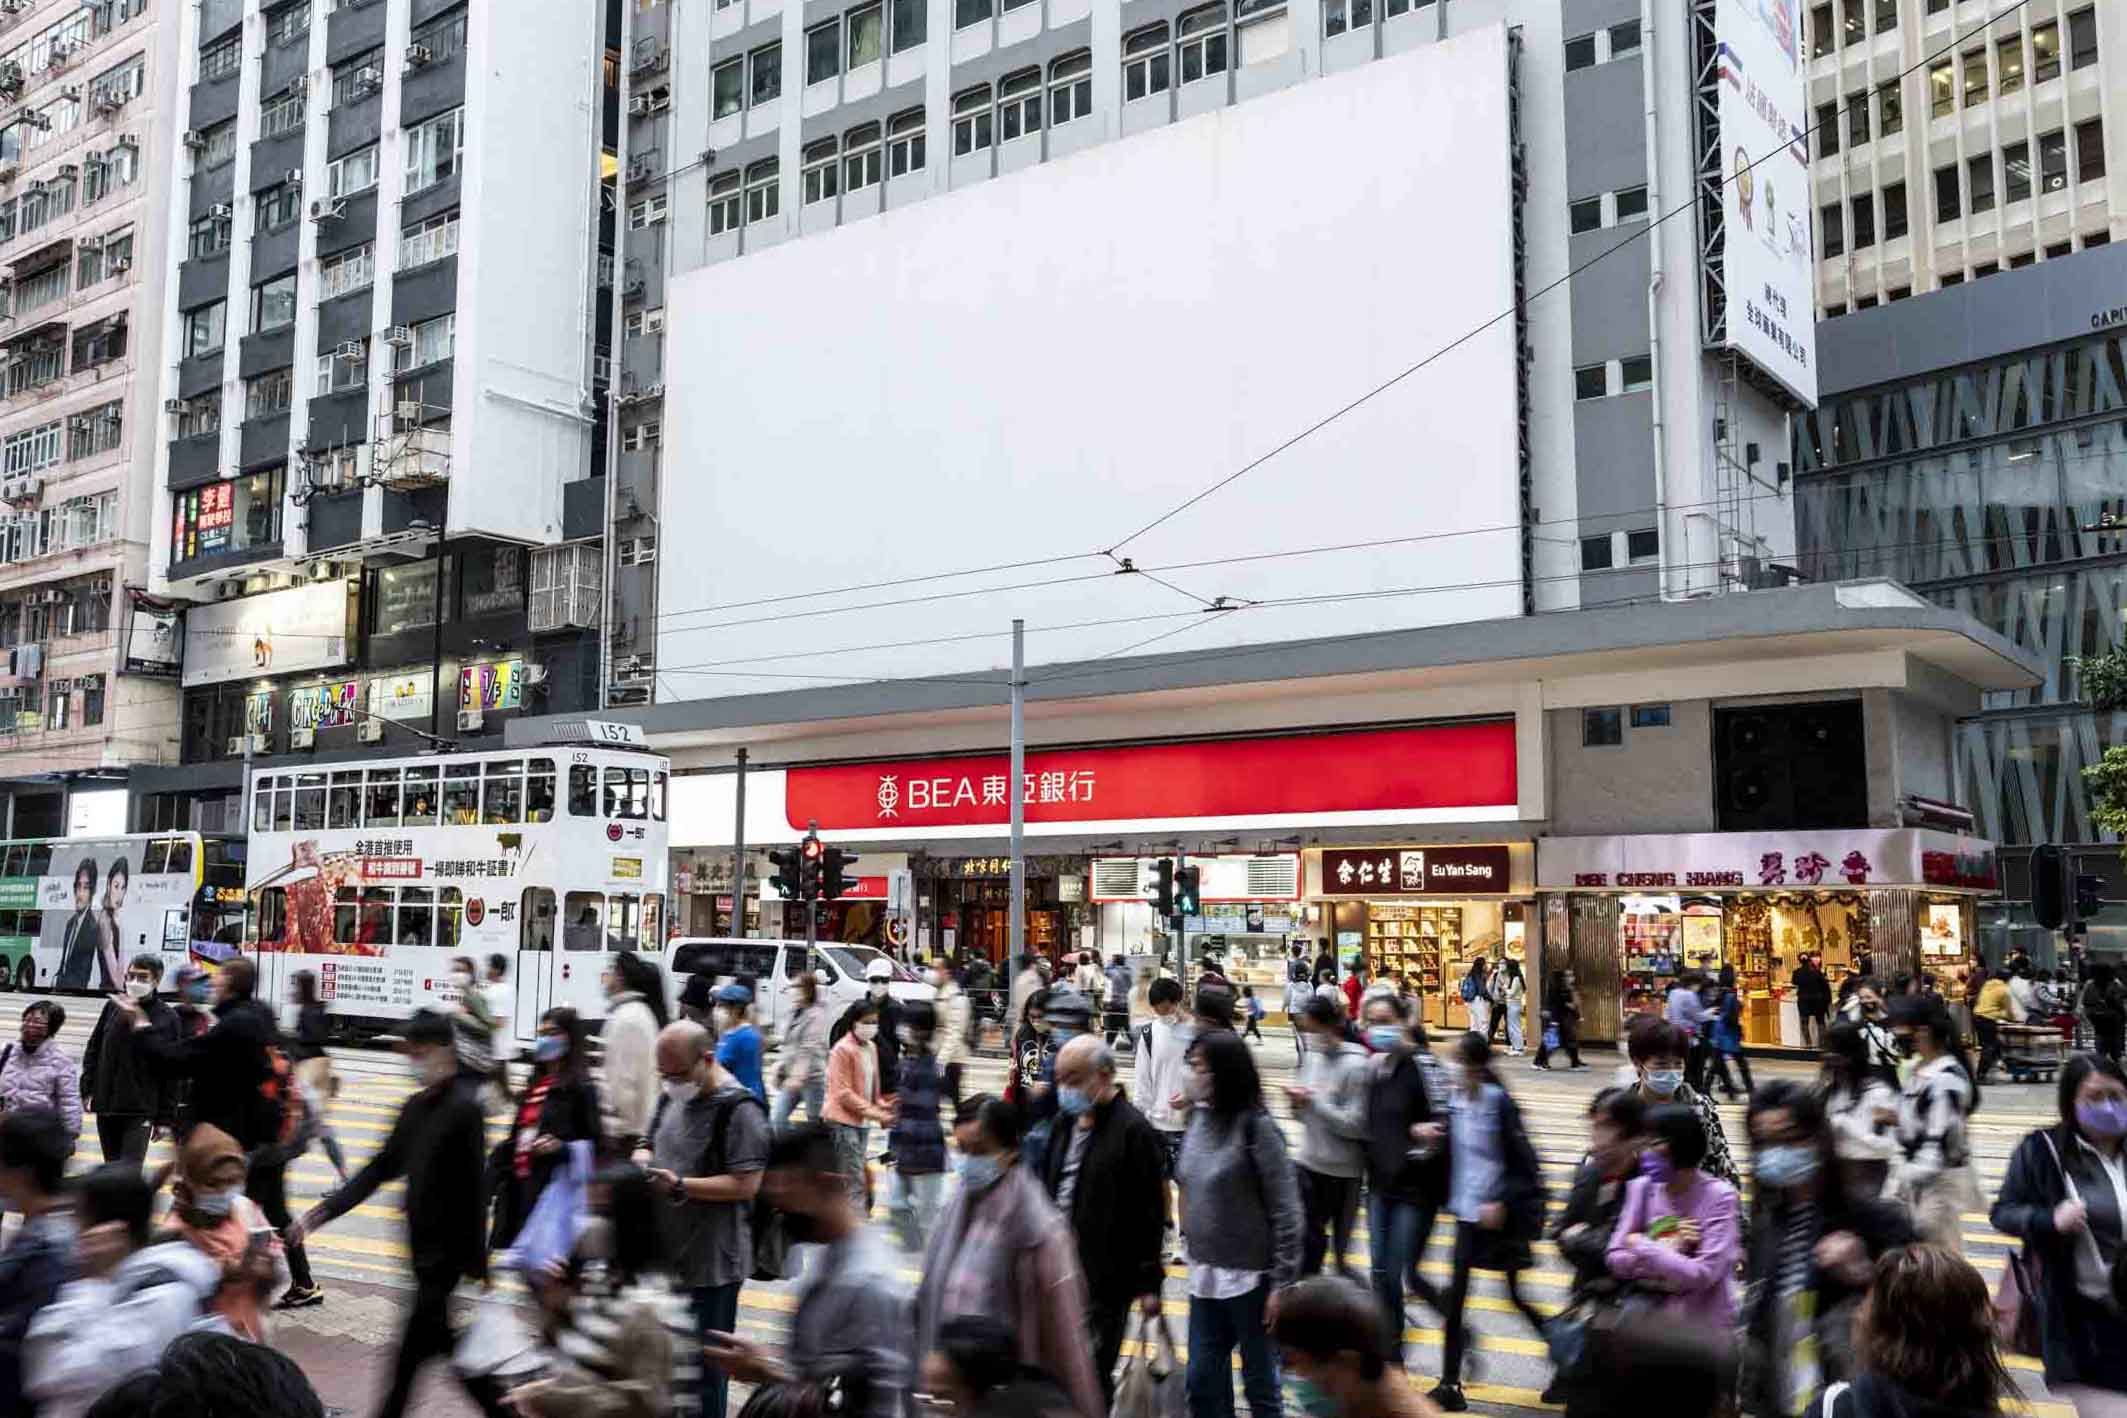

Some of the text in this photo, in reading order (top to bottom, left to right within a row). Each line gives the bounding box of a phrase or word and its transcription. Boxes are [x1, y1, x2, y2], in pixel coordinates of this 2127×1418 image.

[2091, 306, 2127, 329] CAPI
[600, 724, 632, 742] 152
[572, 752, 589, 763] 152
[908, 776, 977, 809] BEA
[1336, 857, 1493, 886] 余仁生 Eu Yan Sang
[1616, 872, 1676, 888] CHENG
[1686, 871, 1744, 888] HIANG
